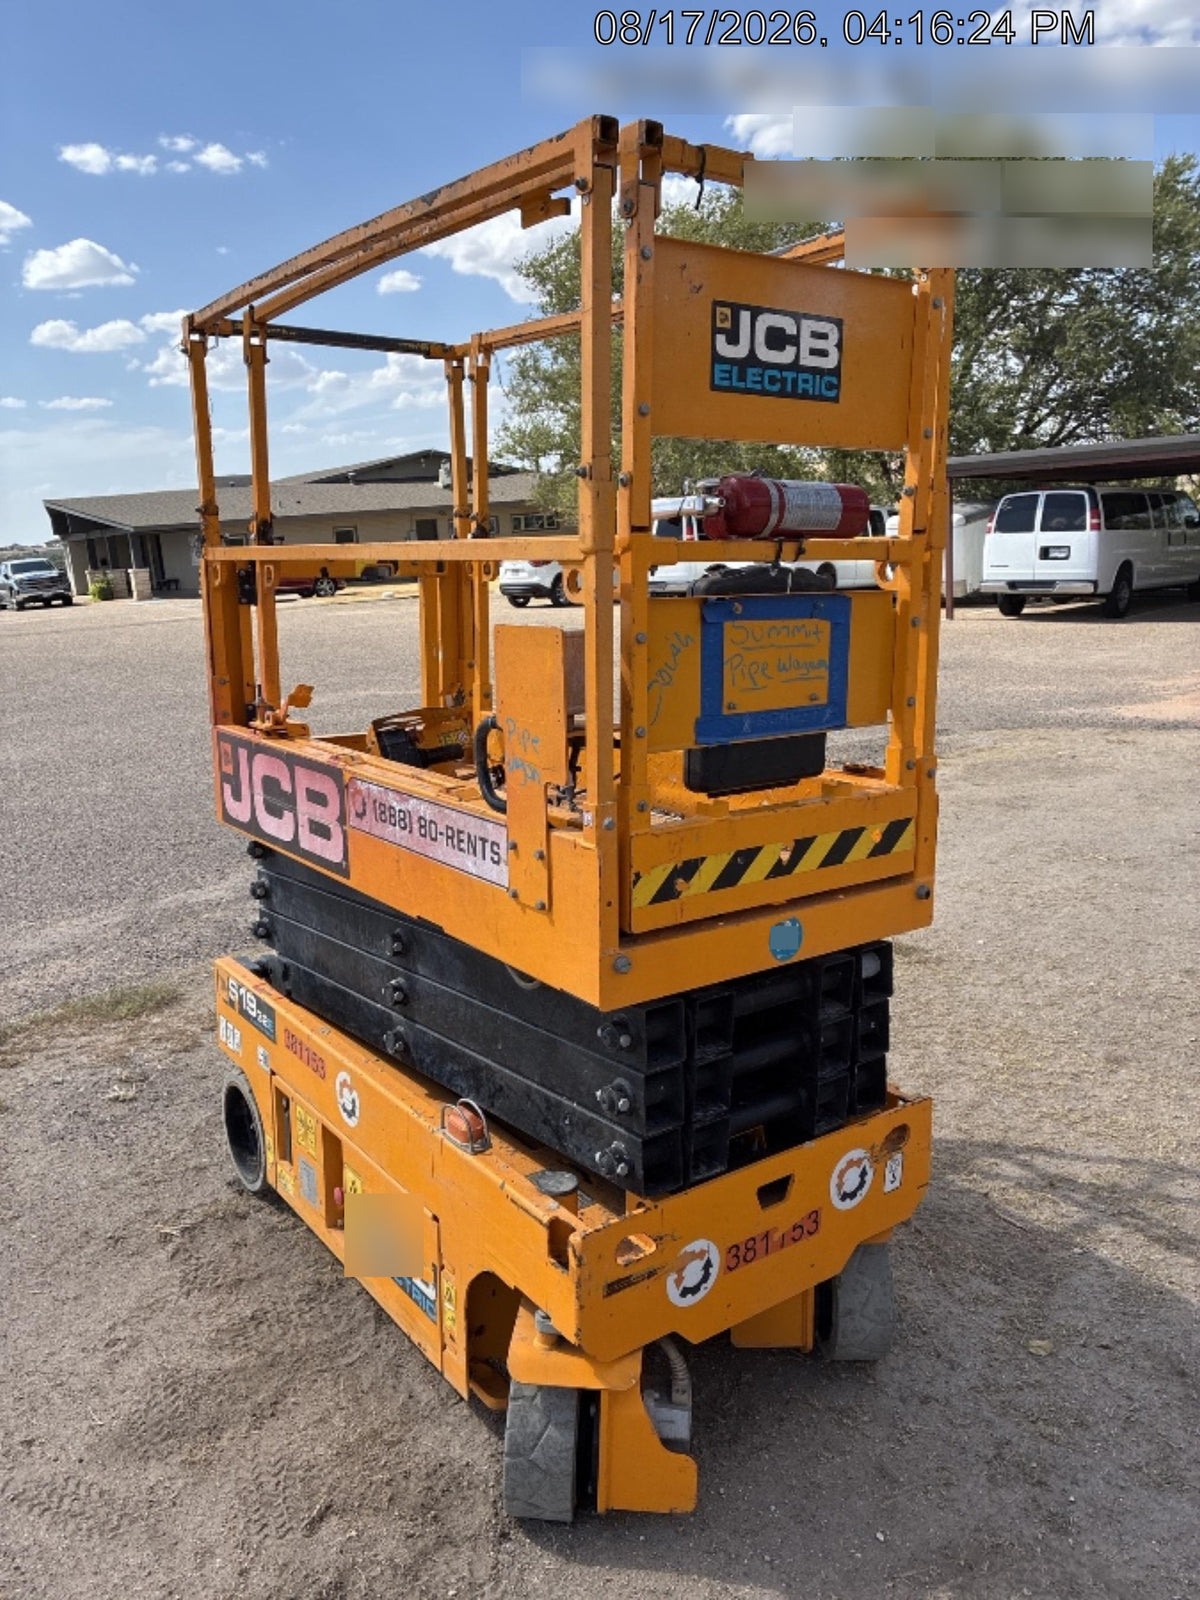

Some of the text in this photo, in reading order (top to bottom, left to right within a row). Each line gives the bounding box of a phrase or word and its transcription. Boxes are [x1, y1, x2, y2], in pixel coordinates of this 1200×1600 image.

[715, 310, 840, 369] JCB
[714, 363, 839, 397] ELECTRIC
[730, 622, 824, 645] Summit
[724, 653, 774, 688] Pipe
[222, 746, 344, 863] JCB
[373, 799, 501, 866] (888) 80-RENTS
